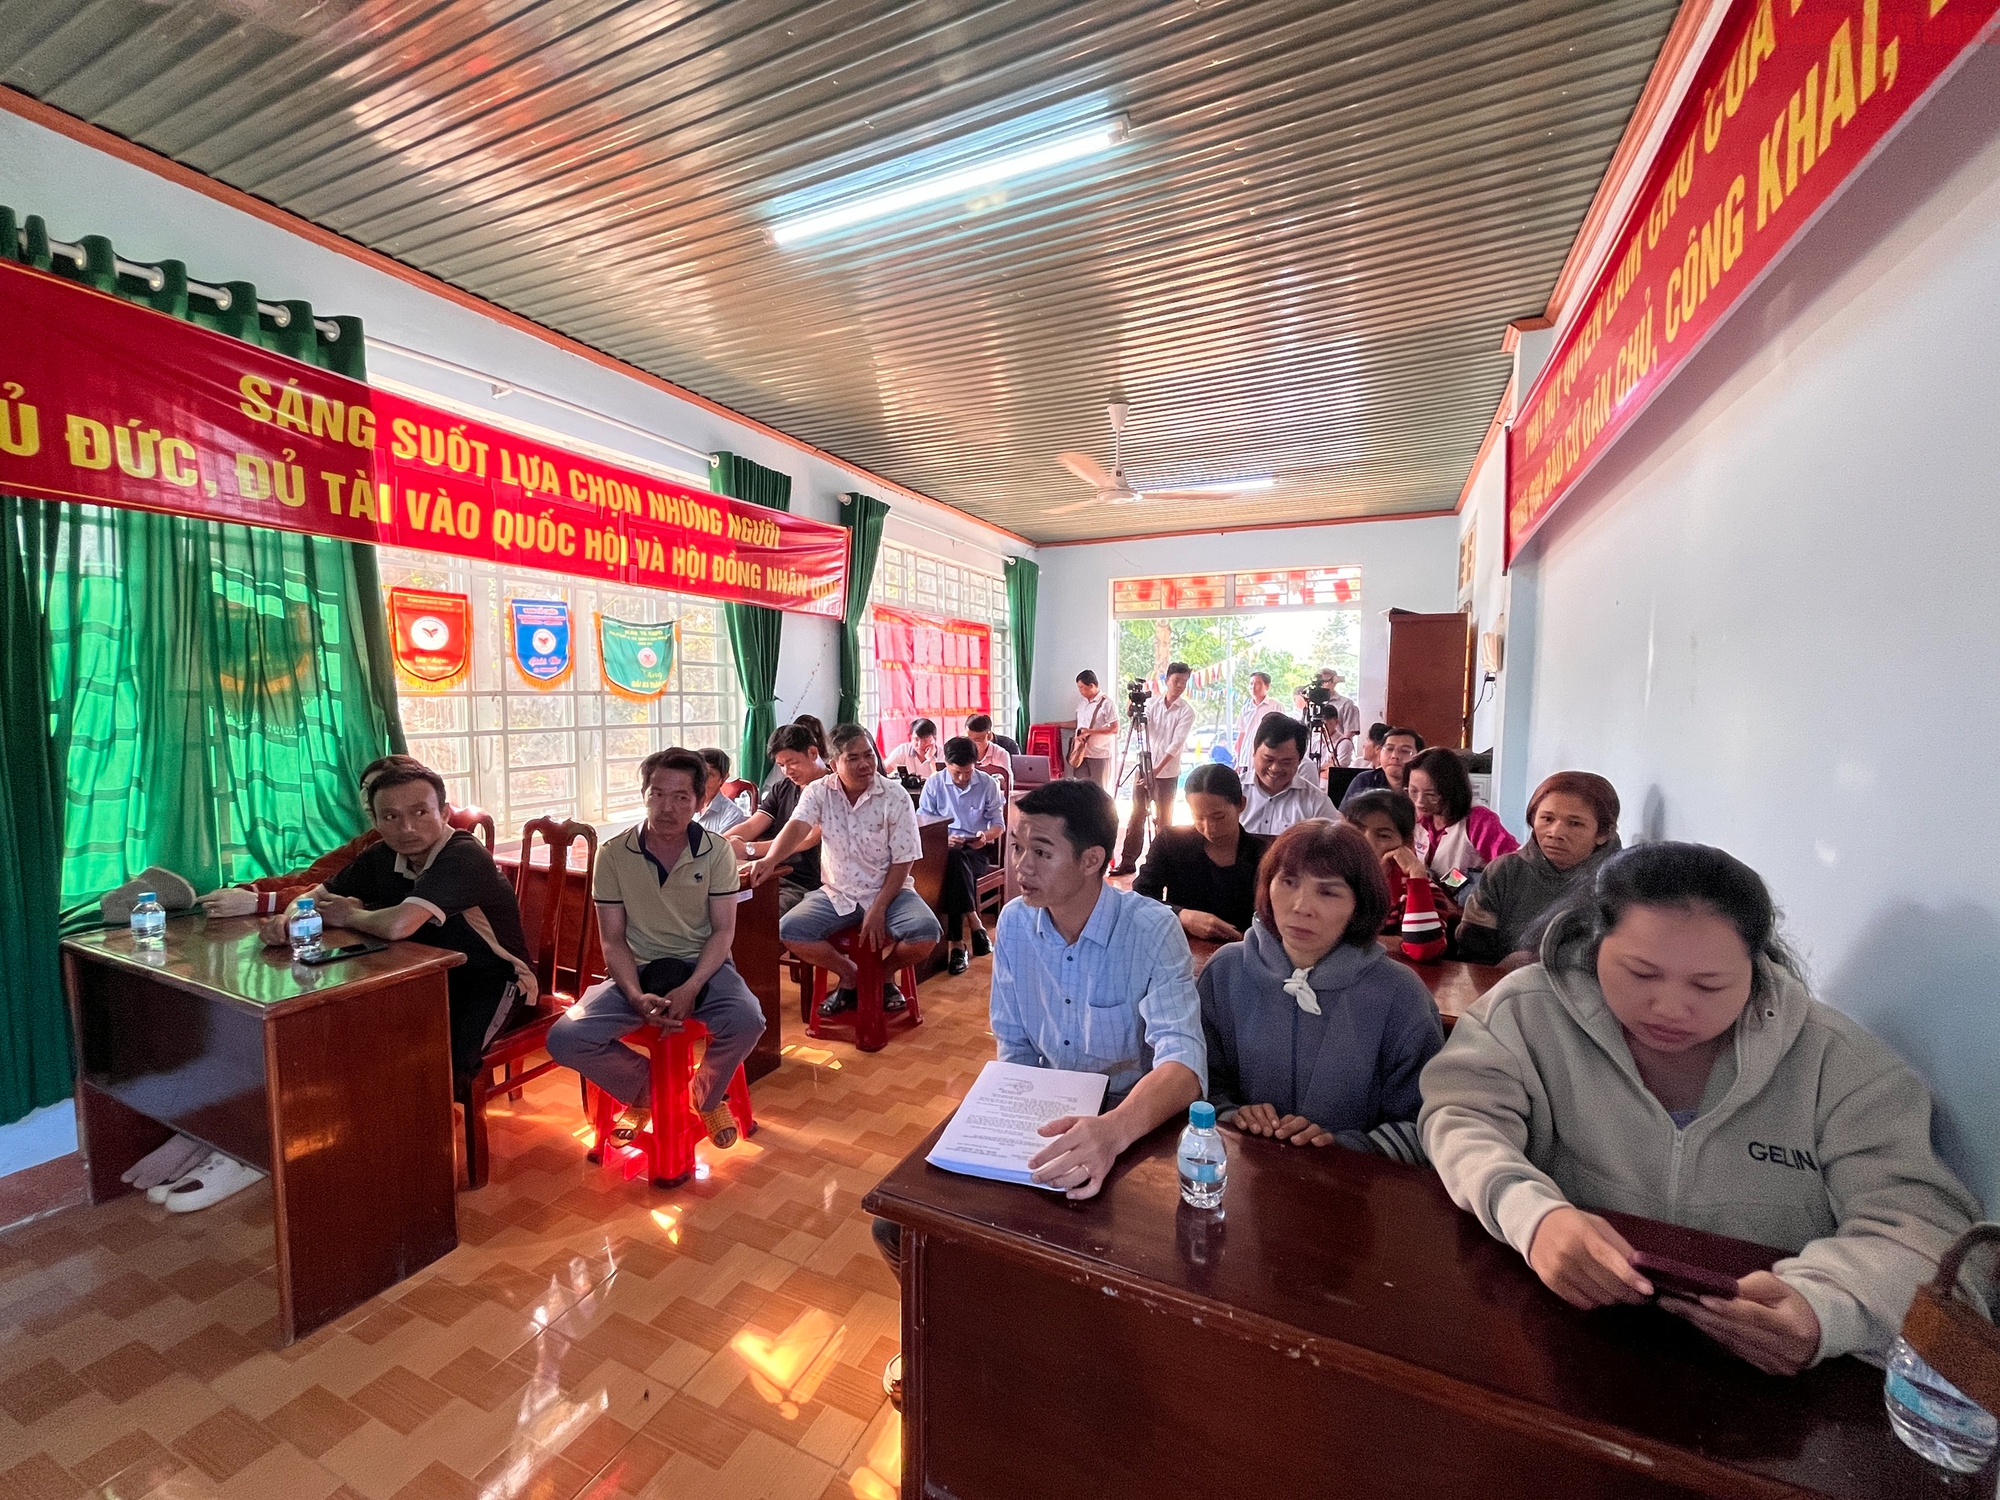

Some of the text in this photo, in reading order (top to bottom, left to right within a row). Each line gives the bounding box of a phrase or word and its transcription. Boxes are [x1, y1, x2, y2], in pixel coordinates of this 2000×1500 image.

[1582, 366, 1611, 452] DÂN
[1615, 286, 1657, 407] CHỦ,
[1666, 174, 1744, 343] CÔNG
[1757, 0, 1899, 232] KHAI,
[65, 413, 218, 498] ĐỨC,
[234, 448, 306, 508] ĐỦ
[321, 469, 391, 524] TÀI
[405, 487, 481, 540] VÀO
[493, 508, 576, 557] QUỐC
[584, 526, 627, 571] HỘI
[635, 536, 665, 573] VÀ
[672, 544, 706, 585] HỘI
[712, 549, 761, 590] ĐỒNG
[766, 566, 809, 598] NHÂN
[238, 374, 780, 550] SÁNG SUỐT LỰA CHỌN NHỮNG NGƯỜI
